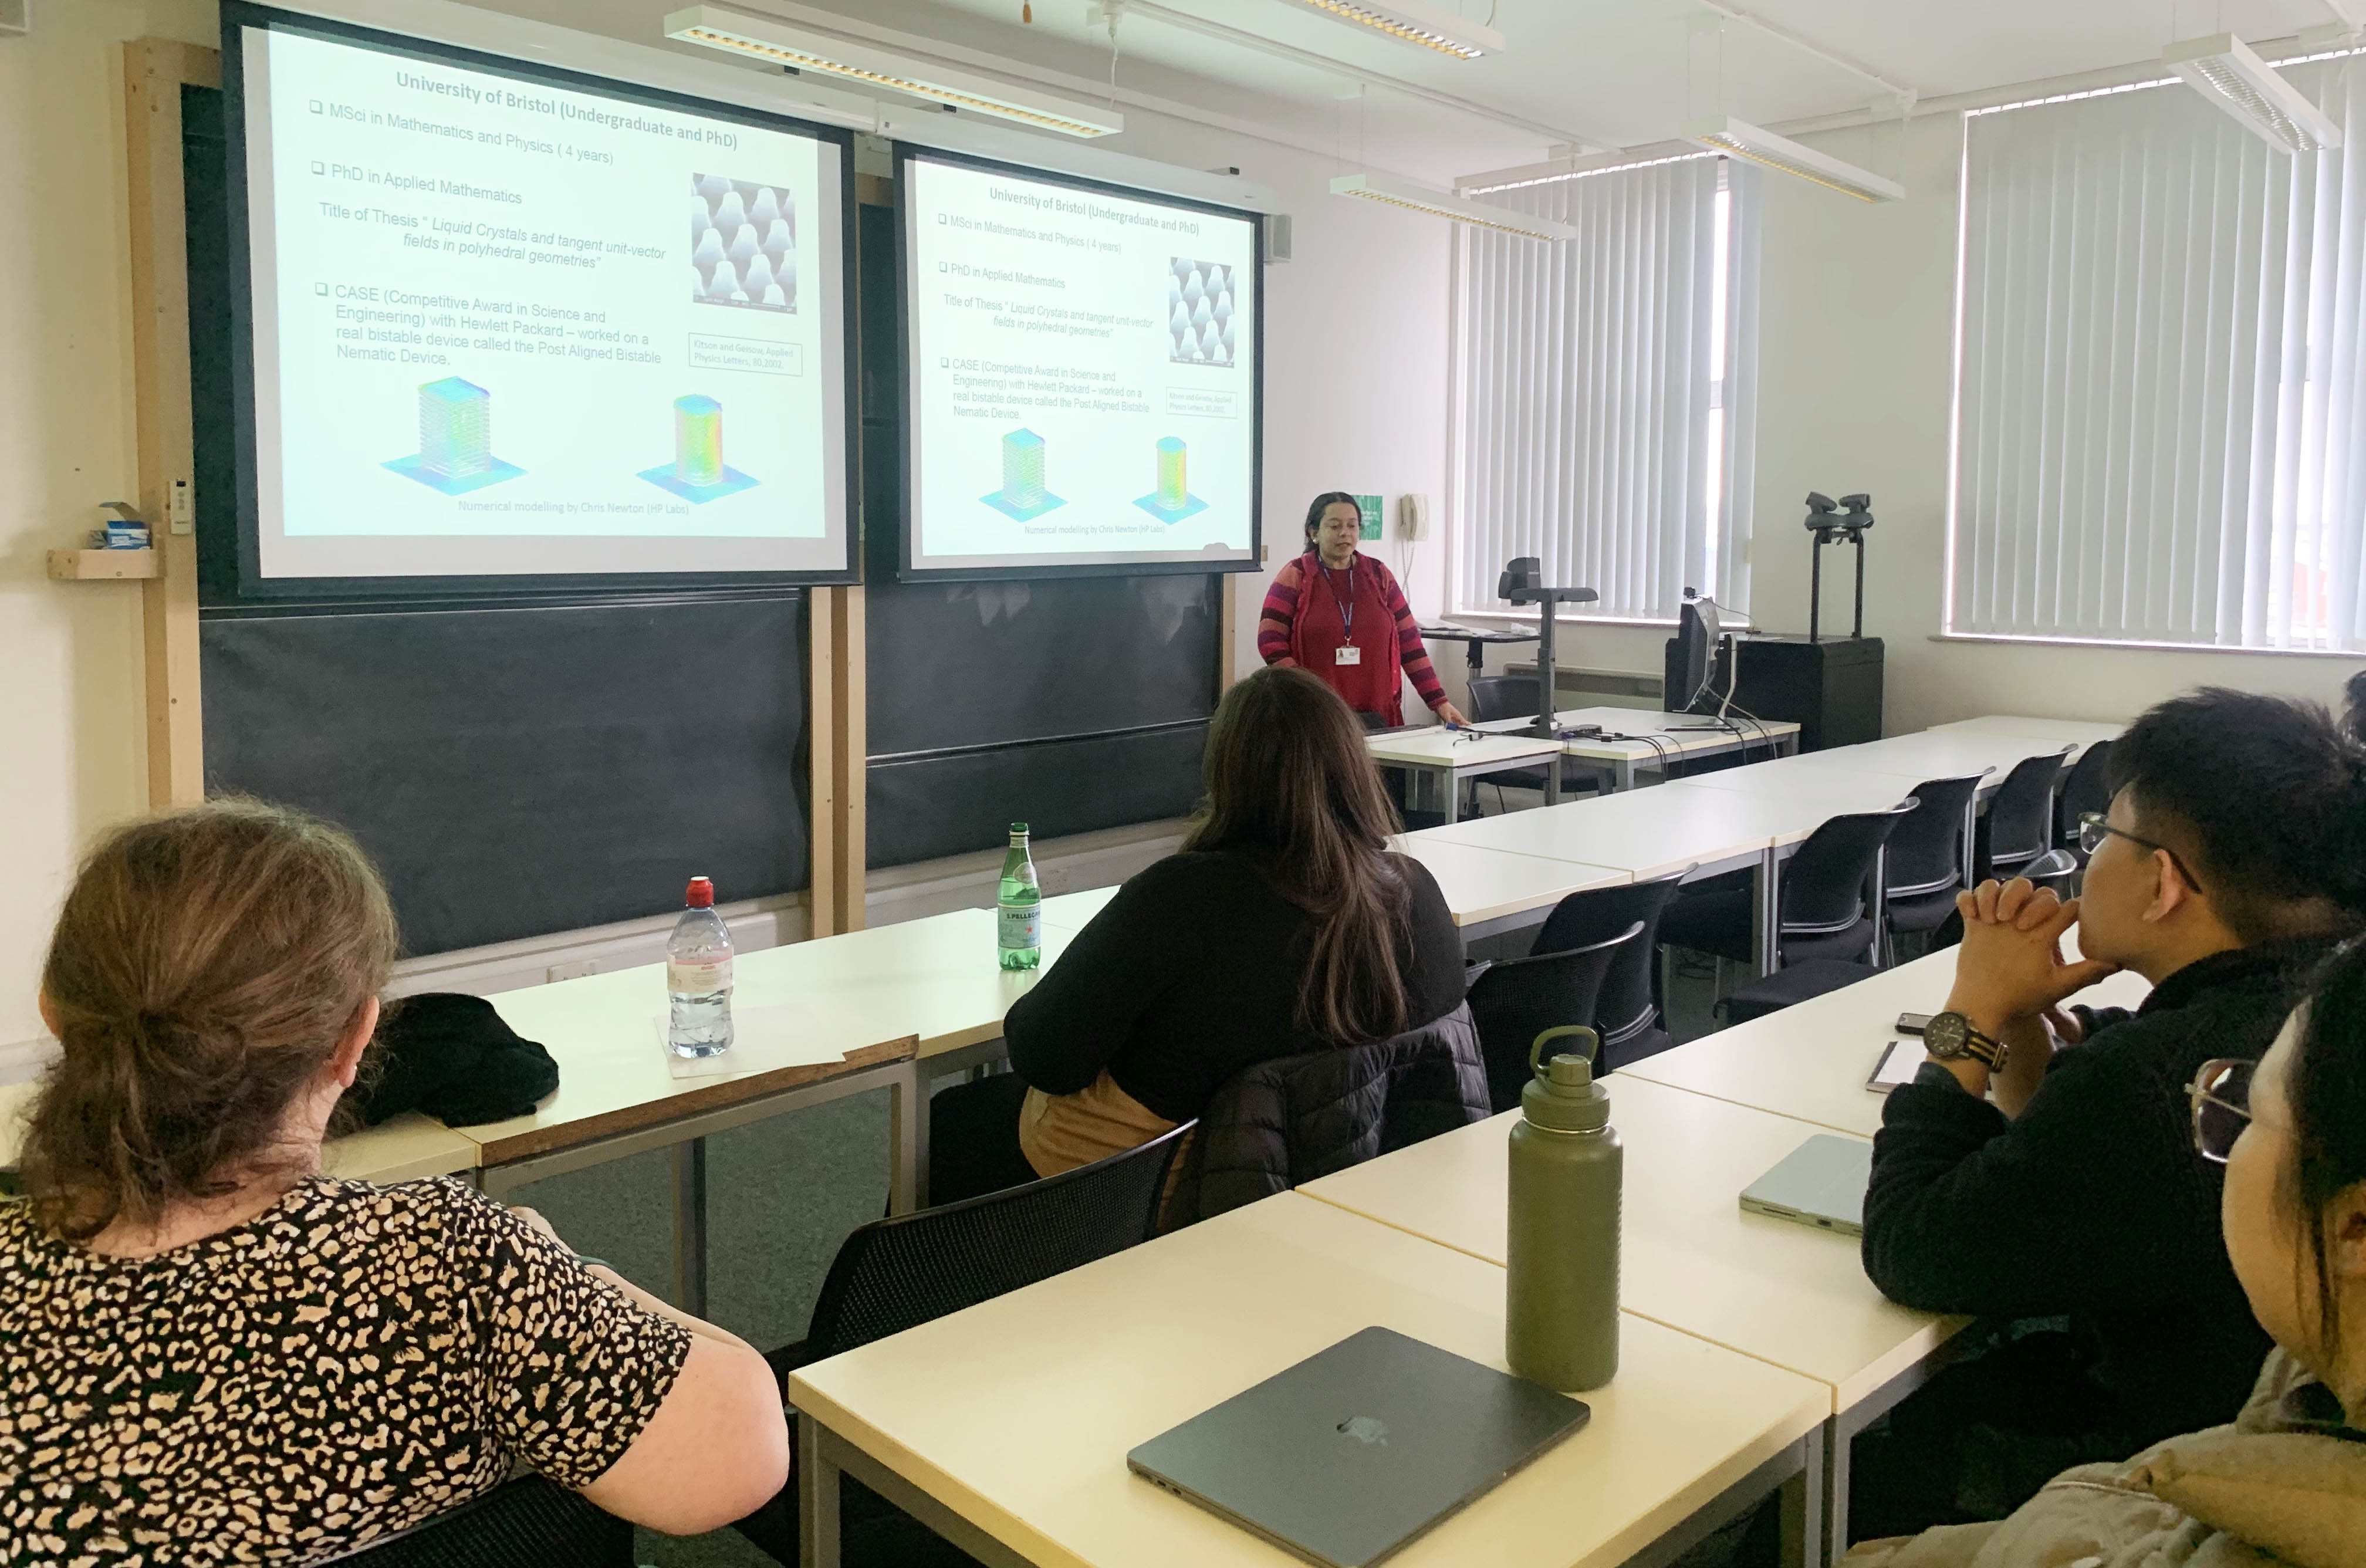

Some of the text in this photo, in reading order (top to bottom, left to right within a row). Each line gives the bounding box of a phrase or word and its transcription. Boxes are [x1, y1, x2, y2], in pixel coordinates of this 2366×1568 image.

[397, 72, 738, 151] University of Bristol (Undergraduate and PhD)
[330, 103, 366, 123] MSci
[371, 110, 383, 125] in
[388, 113, 474, 141] Mathematics
[478, 132, 501, 145] and
[506, 134, 553, 153] Physics
[565, 145, 573, 156] 4
[577, 147, 614, 165] years)
[332, 164, 522, 204] PhD in Applied Mathematics
[991, 187, 1199, 237] University of Bristol (Undergraduate and PhD)
[319, 202, 350, 219] Title
[354, 208, 369, 221] of
[372, 209, 418, 227] Thesis
[432, 217, 472, 235] Liquid
[476, 223, 528, 242] Crystals
[530, 232, 554, 245] and
[557, 236, 603, 253] tangent
[606, 242, 667, 259] unit-vector
[403, 233, 440, 249] fields
[444, 238, 454, 251] in
[459, 239, 525, 259] polyhedral
[951, 215, 972, 229] MSci
[975, 220, 981, 231] in
[985, 221, 1036, 239] Mathematics
[1038, 232, 1052, 242] and
[1056, 232, 1084, 246] Physics
[1092, 238, 1096, 248] 4
[1099, 240, 1121, 255] years)
[951, 263, 1066, 289] PhD in Applied Mathematics
[336, 285, 606, 323] CASE (Competitive Award in Science and
[944, 294, 962, 306] Title
[965, 297, 974, 307] of
[975, 298, 1003, 311] Thesis
[1010, 302, 1035, 315] Liquid
[1037, 305, 1068, 319] Crystals
[1070, 311, 1084, 320] and
[1086, 312, 1114, 325] tangent
[1116, 316, 1153, 328] unit-vector
[336, 305, 425, 328] Engineering)
[430, 315, 455, 327] with
[461, 316, 509, 333] Hewlett
[513, 320, 563, 337] Packard
[577, 328, 619, 342] worked
[624, 333, 637, 344] on
[642, 335, 648, 344] a
[993, 315, 1015, 328] fields
[1018, 319, 1024, 329] in
[1026, 321, 1066, 333] polyhedral
[337, 327, 661, 363] real bistable device called the Post Aligned Bistable
[337, 344, 450, 365] Nematic Device.
[953, 359, 1116, 381] CASE (Competitive Award in Science and
[954, 374, 1006, 390] Engineering)
[1009, 379, 1025, 390] with
[1027, 380, 1056, 391] Hewlett
[1059, 382, 1089, 394] Packard
[1098, 386, 1124, 397] worked
[953, 391, 1150, 412] real bistable device called the Post Aligned Bistable
[954, 405, 1021, 420] Nematic Device.
[458, 501, 689, 516] Numerical modelling by Chris Newton (HP Labs)
